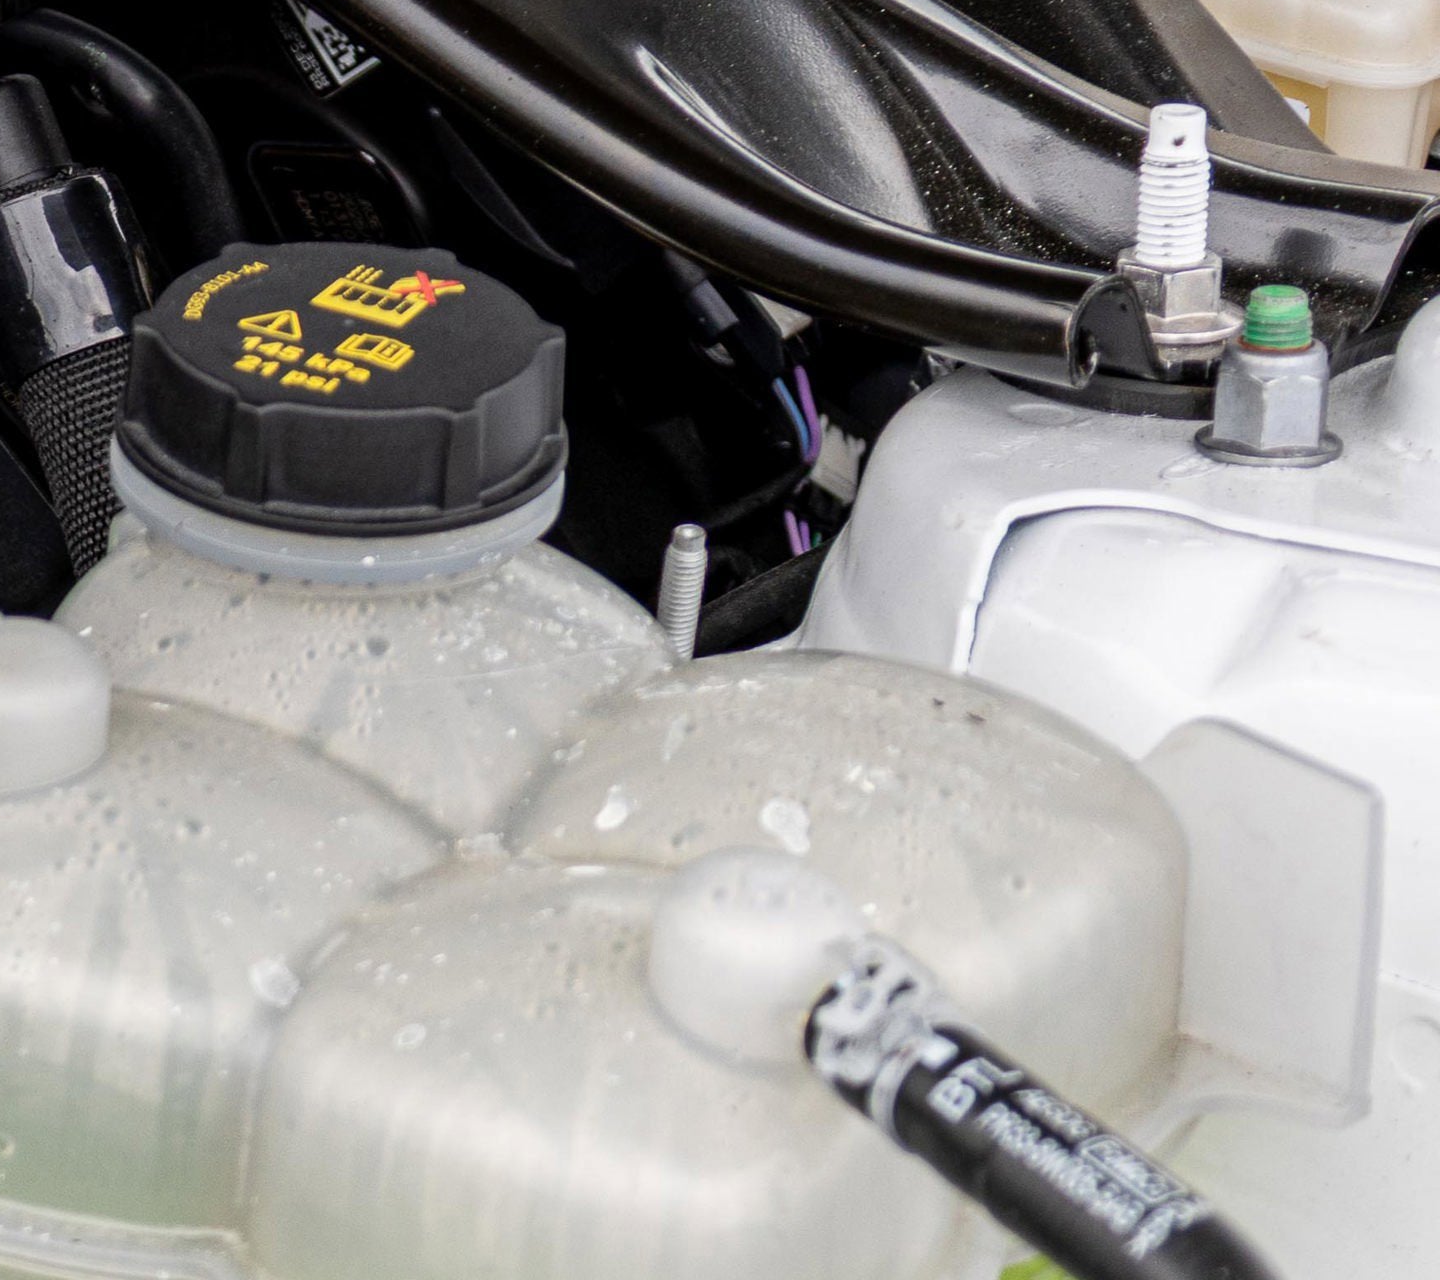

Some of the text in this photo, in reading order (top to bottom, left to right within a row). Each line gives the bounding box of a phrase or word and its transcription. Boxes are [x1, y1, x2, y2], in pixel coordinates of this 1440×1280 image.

[232, 354, 342, 395] 21 psi
[241, 335, 372, 384] 145 kPa
[925, 1056, 1025, 1124] BTL
